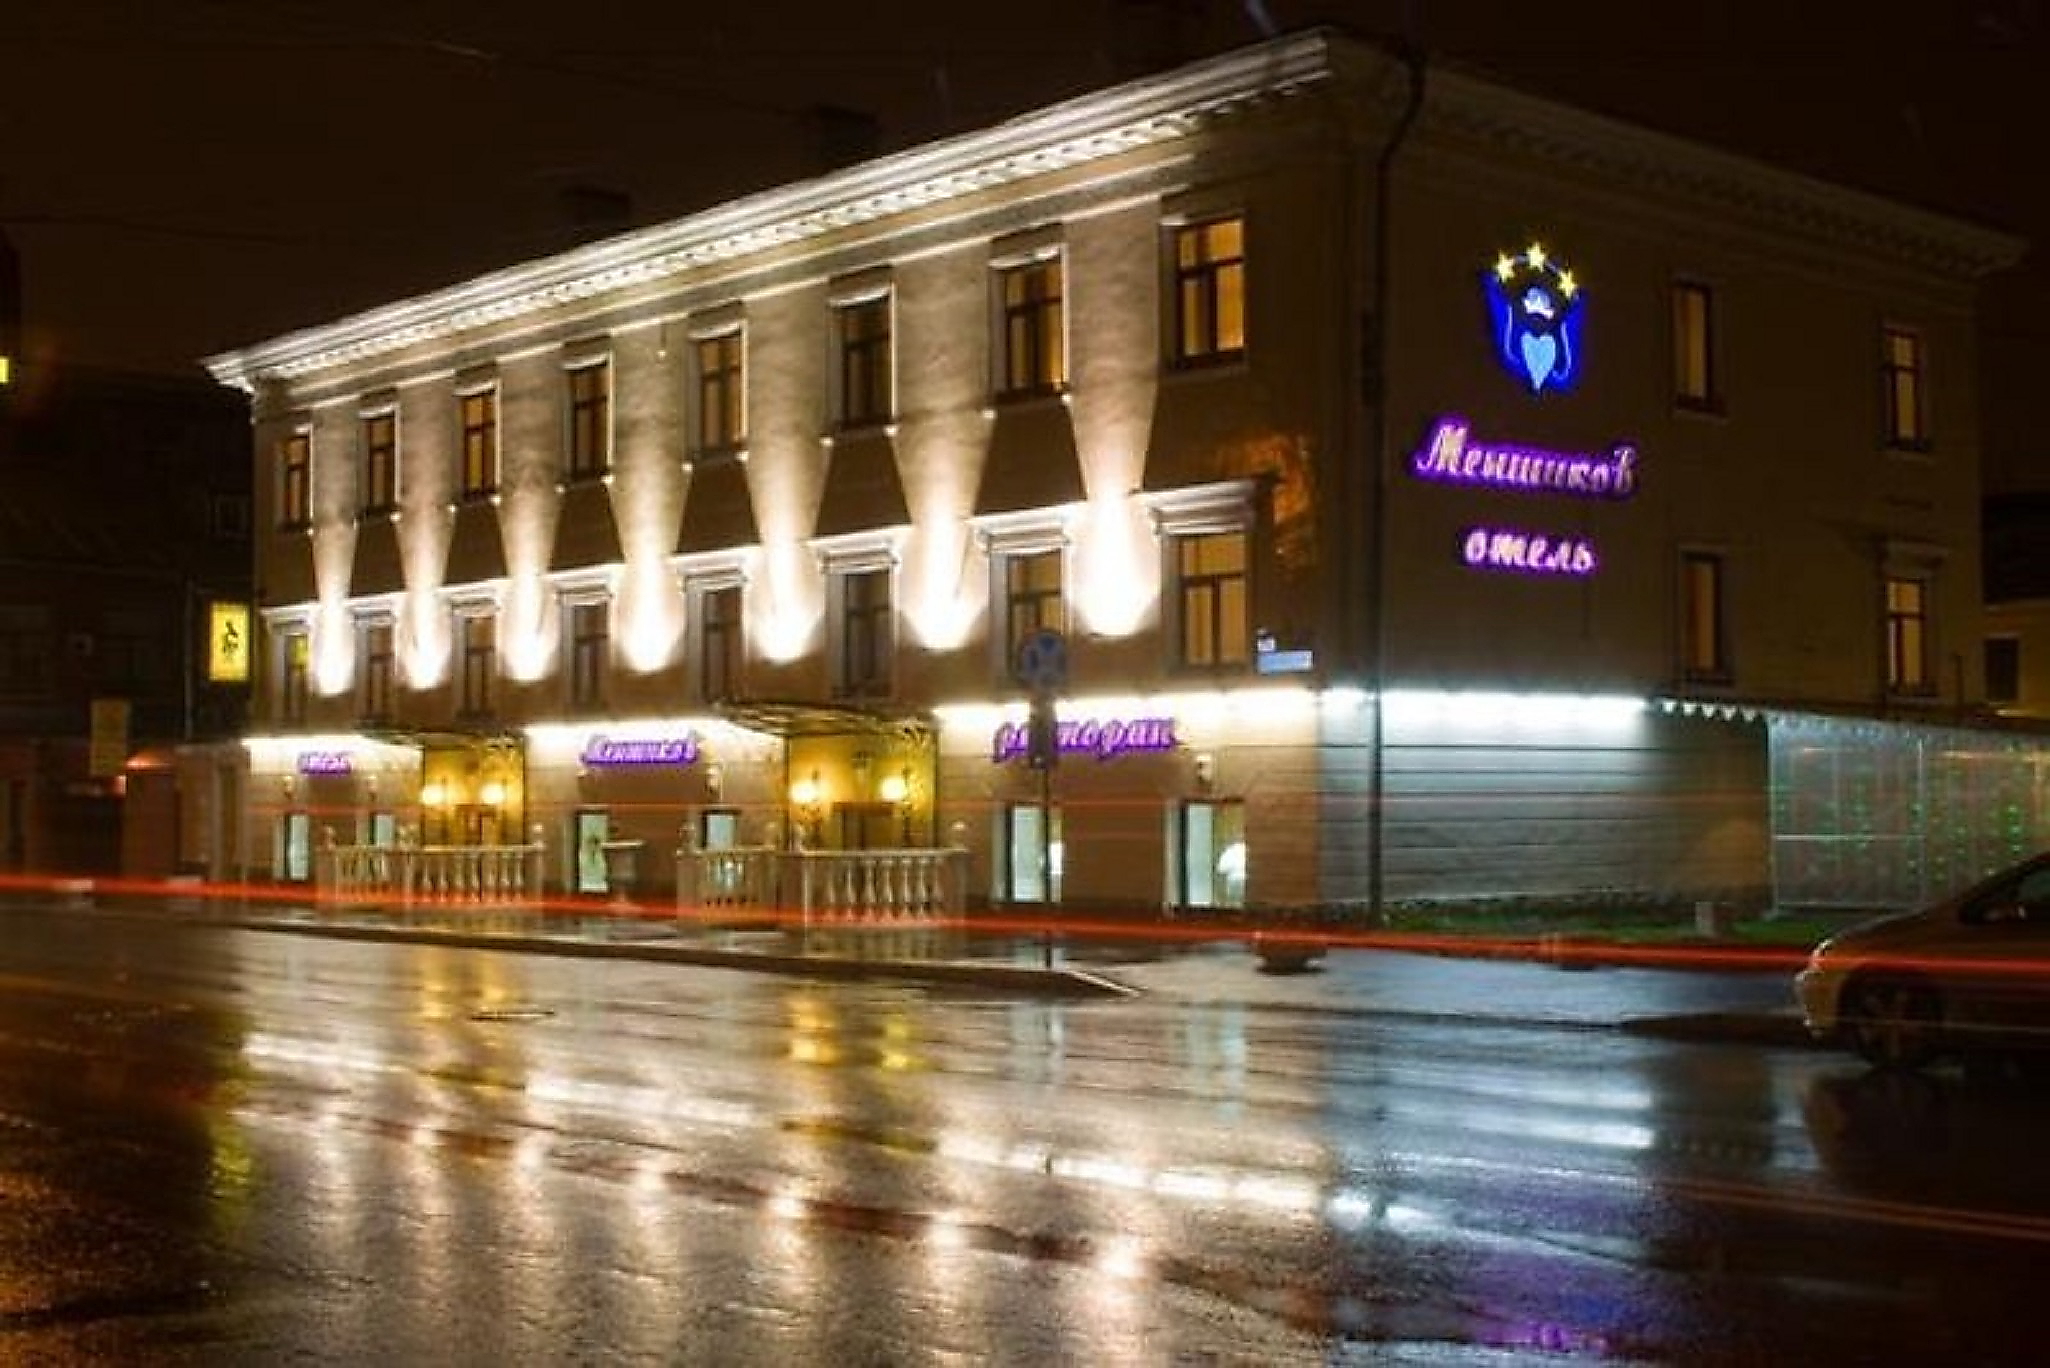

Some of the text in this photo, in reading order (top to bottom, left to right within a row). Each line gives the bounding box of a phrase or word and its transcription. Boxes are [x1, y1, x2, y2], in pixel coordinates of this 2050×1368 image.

[1415, 422, 1638, 493] Меншиков
[1463, 531, 1595, 572] отель
[991, 718, 1175, 761] реторан
